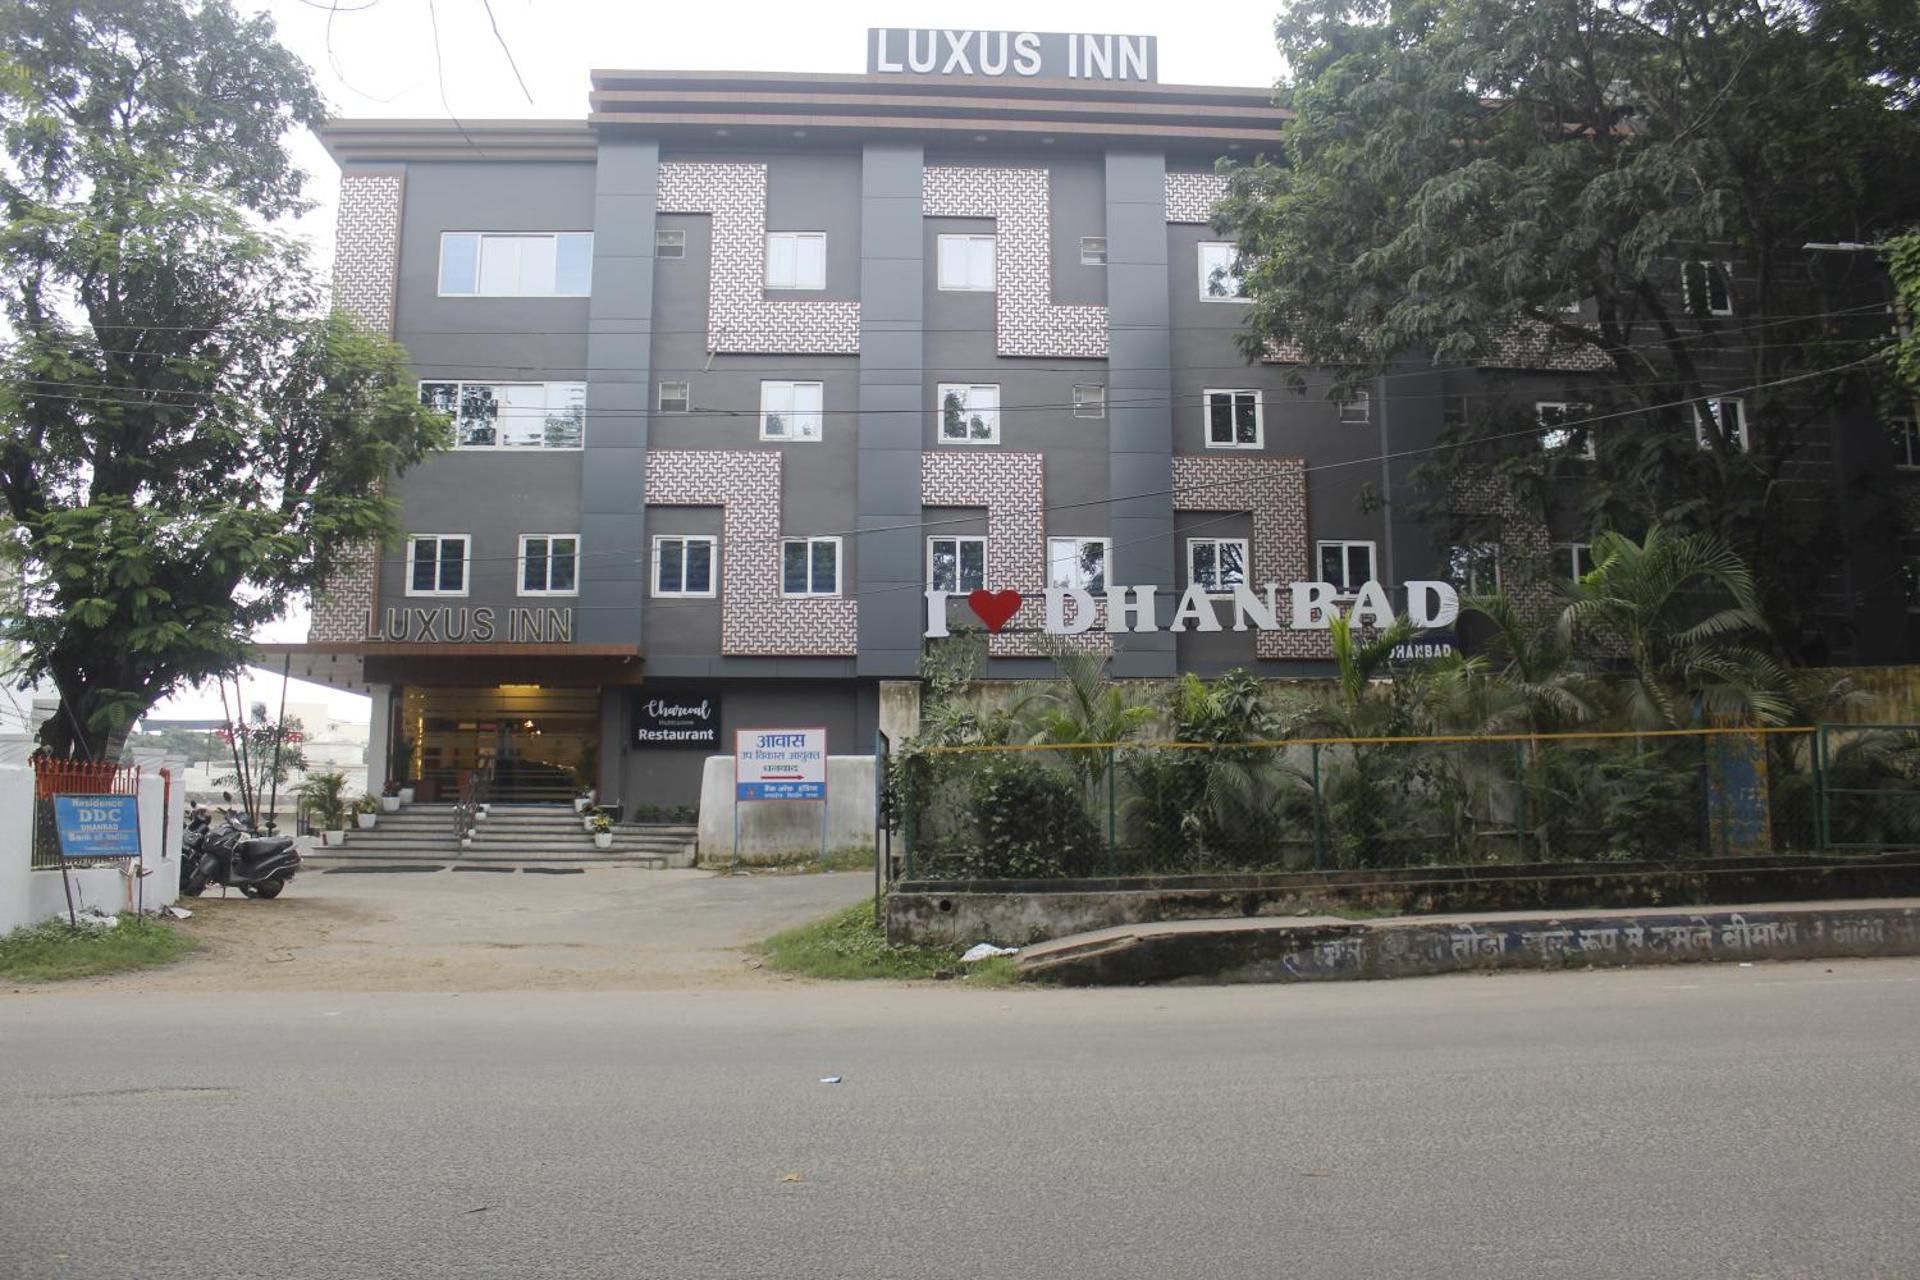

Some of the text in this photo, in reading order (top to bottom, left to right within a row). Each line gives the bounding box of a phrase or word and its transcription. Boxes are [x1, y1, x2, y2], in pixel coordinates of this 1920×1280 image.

[877, 29, 1149, 80] LUXUS INN
[924, 580, 1460, 637] I DHANBAD
[365, 607, 572, 642] LUXUS INN
[642, 699, 711, 720] Charcoal
[639, 728, 714, 741] Restaurant
[756, 733, 806, 748] आवास
[79, 808, 122, 822] DDC
